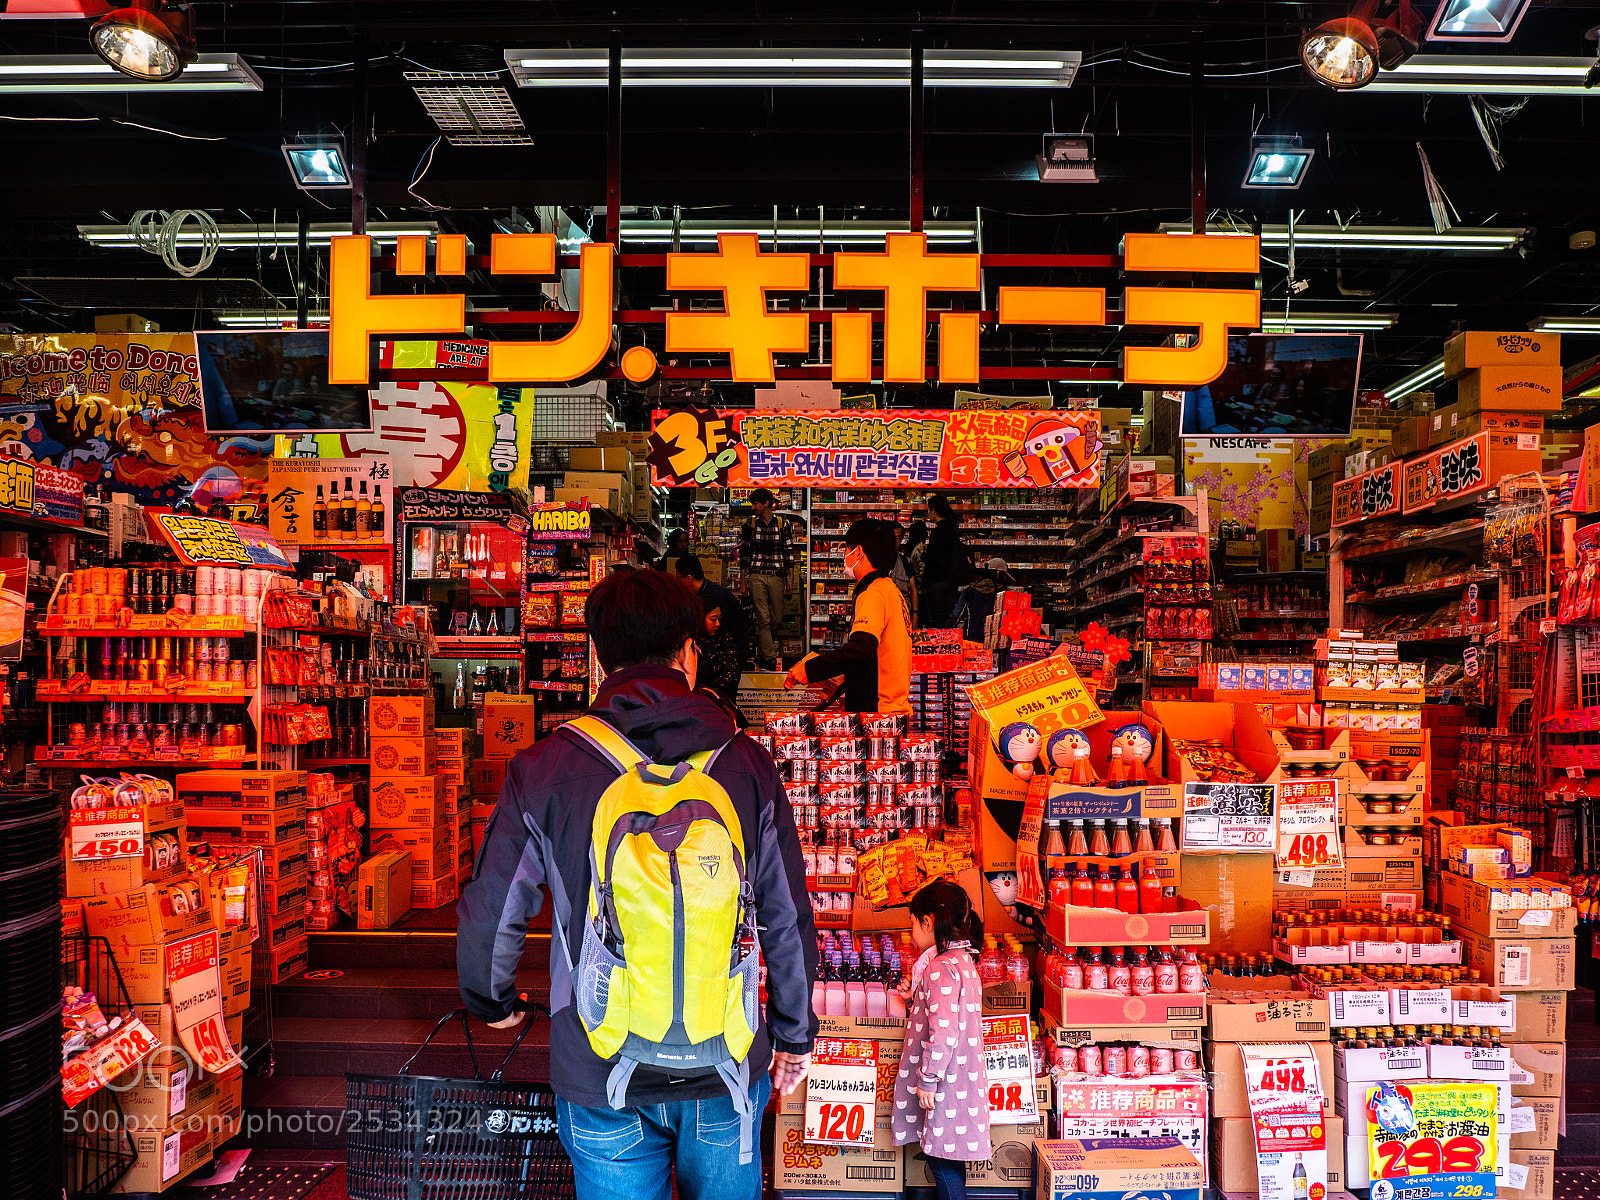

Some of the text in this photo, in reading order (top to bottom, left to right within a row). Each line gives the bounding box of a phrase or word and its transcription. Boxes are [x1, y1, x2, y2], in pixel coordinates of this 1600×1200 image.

[90, 345, 123, 371] to
[450, 352, 467, 364] ARE
[470, 356, 482, 366] AT
[655, 412, 727, 477] 3F
[369, 461, 390, 480] 極
[694, 449, 737, 484] GO
[856, 454, 939, 481] 관련식품
[1441, 439, 1482, 492] 珍味
[1362, 467, 1393, 515] 珍味
[532, 511, 591, 531] HARIBO
[988, 665, 1054, 701] 推荐商品
[1016, 700, 1044, 717] ドラえもん
[1390, 747, 1421, 755] 15027-70
[990, 787, 1006, 795] MADE
[1280, 784, 1331, 798] 推荐商品
[1263, 787, 1273, 815] プライス
[85, 808, 129, 822] 推荐商品
[77, 839, 139, 857] 450
[1288, 833, 1328, 865] 498
[169, 937, 214, 969] 推荐商品
[819, 1024, 850, 1033] 泉株式会社
[114, 1029, 151, 1066] 128
[813, 1040, 873, 1057] 推荐商品
[809, 1079, 875, 1093] クレヨンしんちゃんラムネ
[1090, 1089, 1176, 1111] 推荐商品
[819, 1103, 864, 1140] 120
[1448, 1120, 1489, 1136] お醤油
[783, 1142, 838, 1156] しんちゃん
[1377, 1136, 1485, 1178] 298
[783, 1156, 823, 1169] ラムネ
[1077, 1174, 1099, 1191] 460
[1453, 1184, 1484, 1197] 298
[1395, 1187, 1431, 1200] 계란간장
